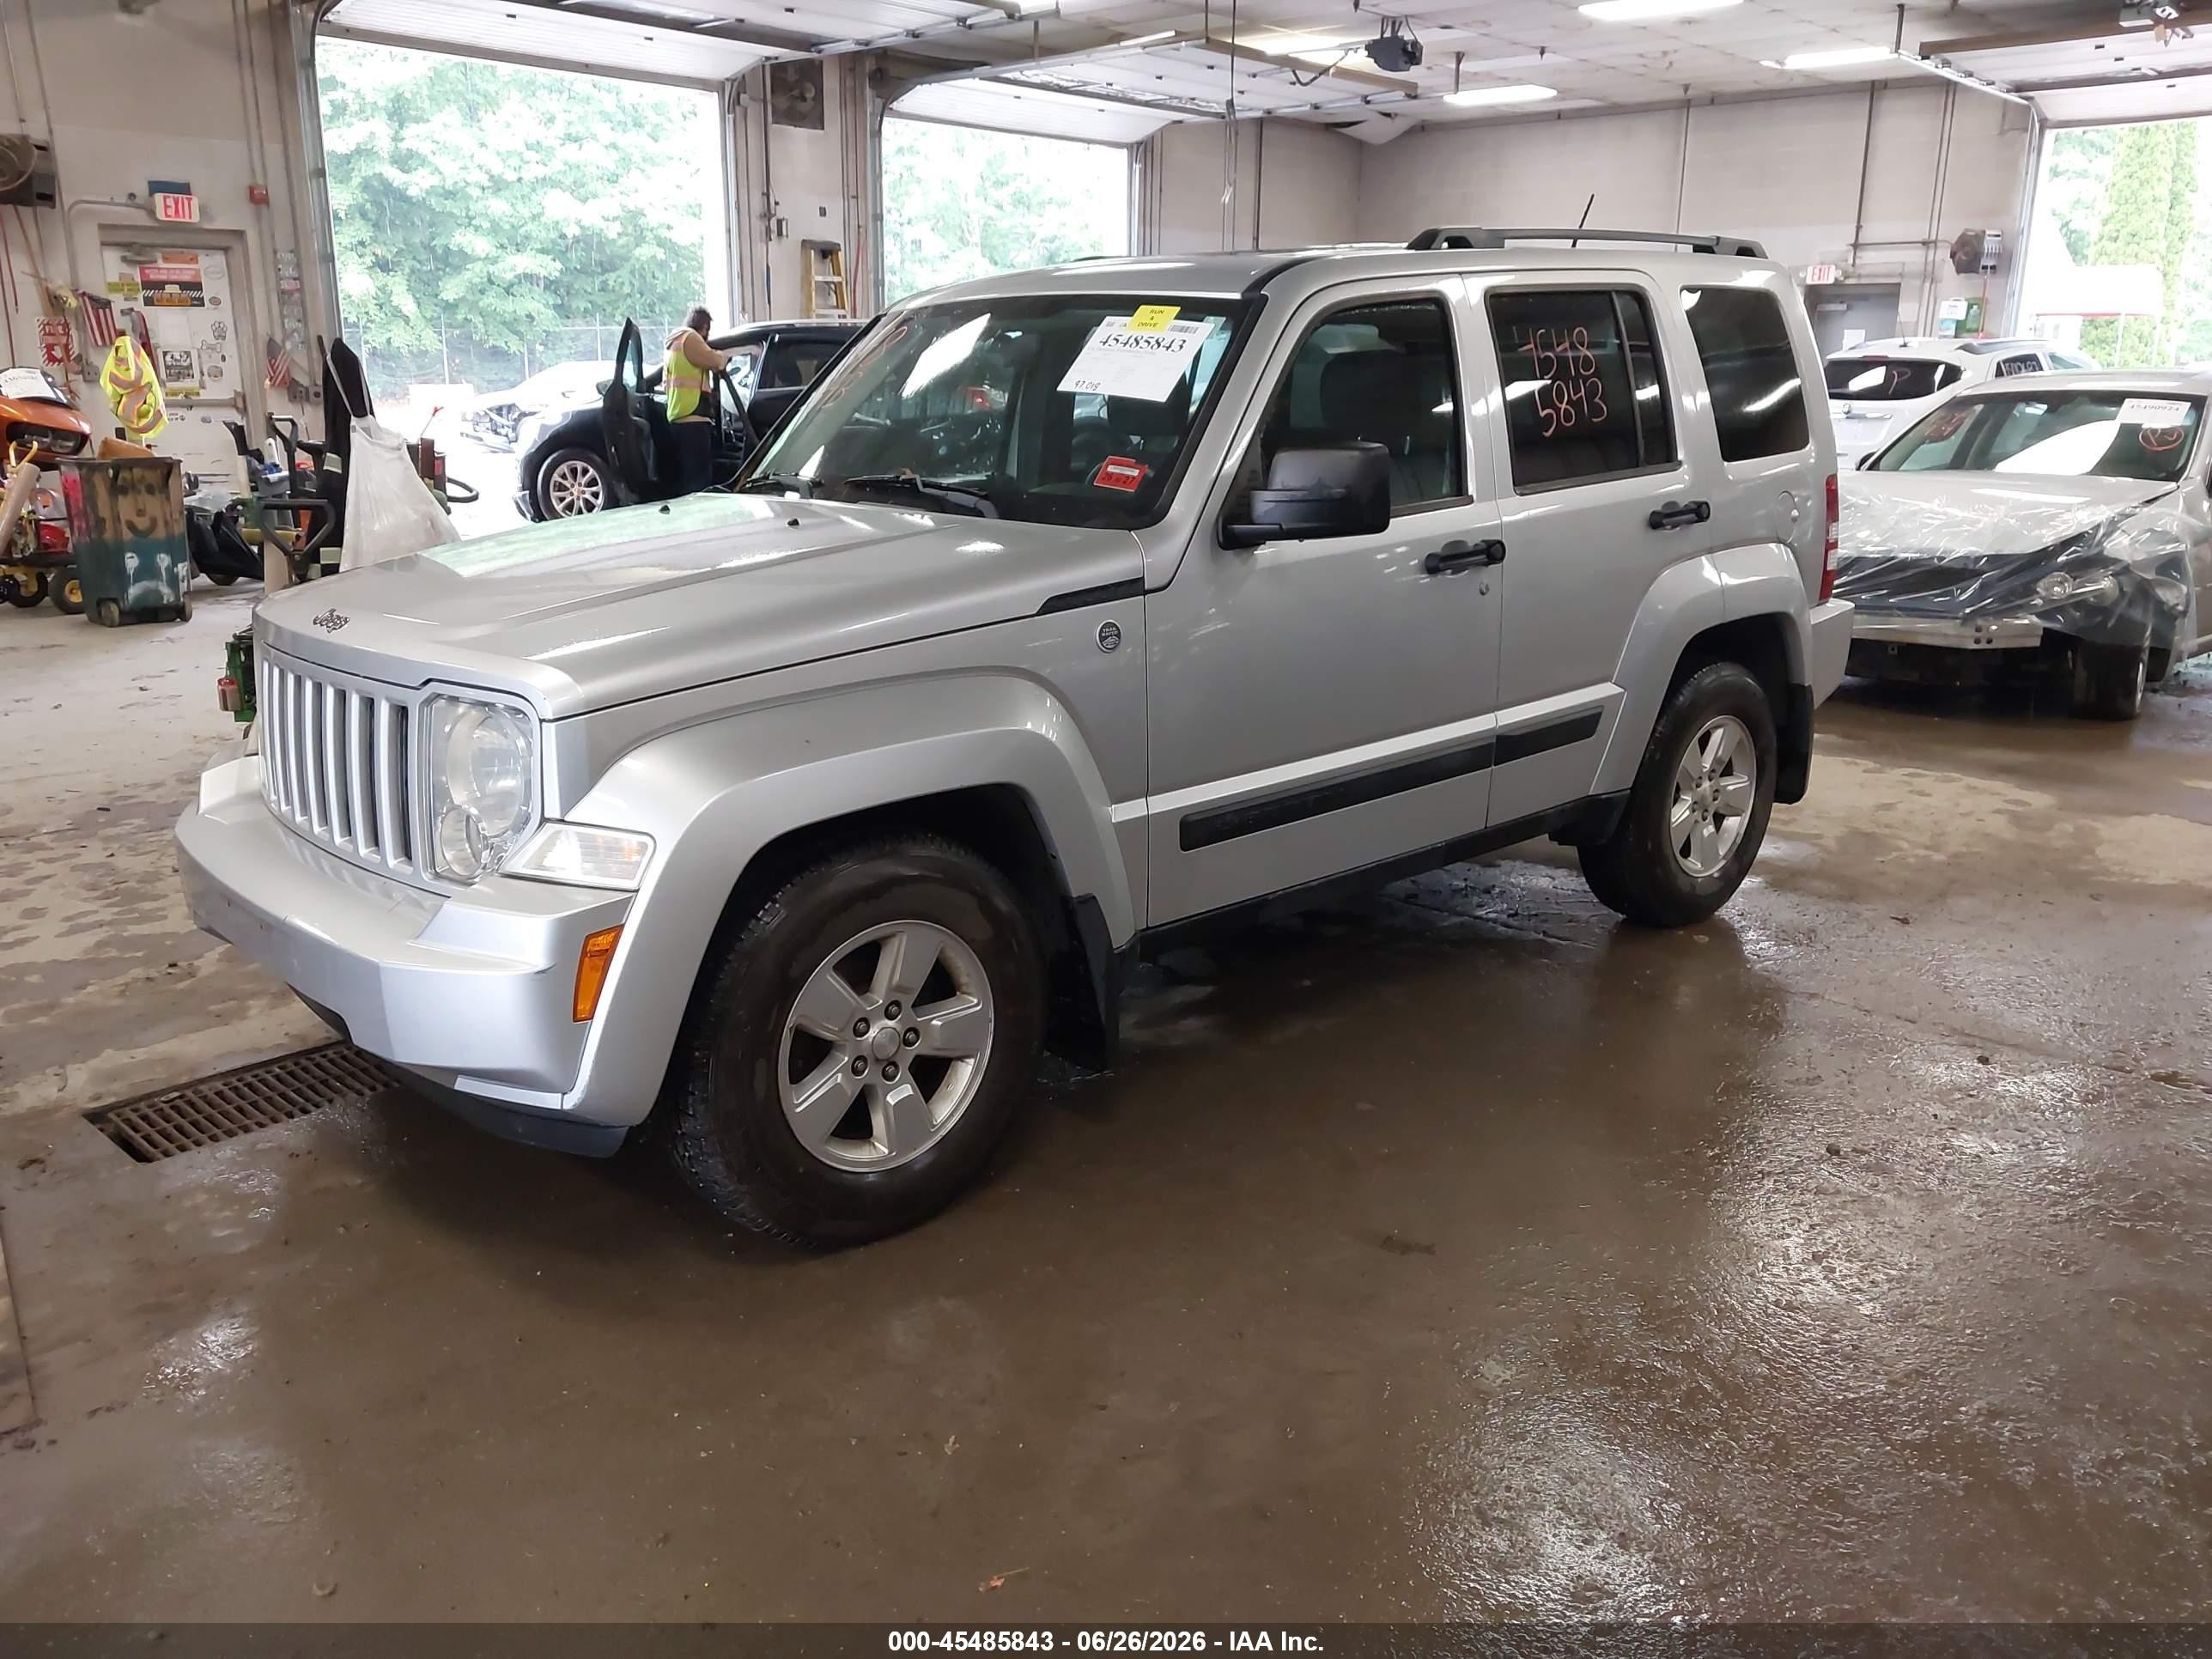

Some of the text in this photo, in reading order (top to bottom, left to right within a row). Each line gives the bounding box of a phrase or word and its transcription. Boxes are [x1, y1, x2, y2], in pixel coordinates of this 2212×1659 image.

[163, 195, 192, 220] EXIT
[1812, 266, 1832, 282] EXIT
[1099, 333, 1187, 352] 45485843
[1513, 326, 1595, 379] 4548
[1534, 378, 1607, 436] 5843
